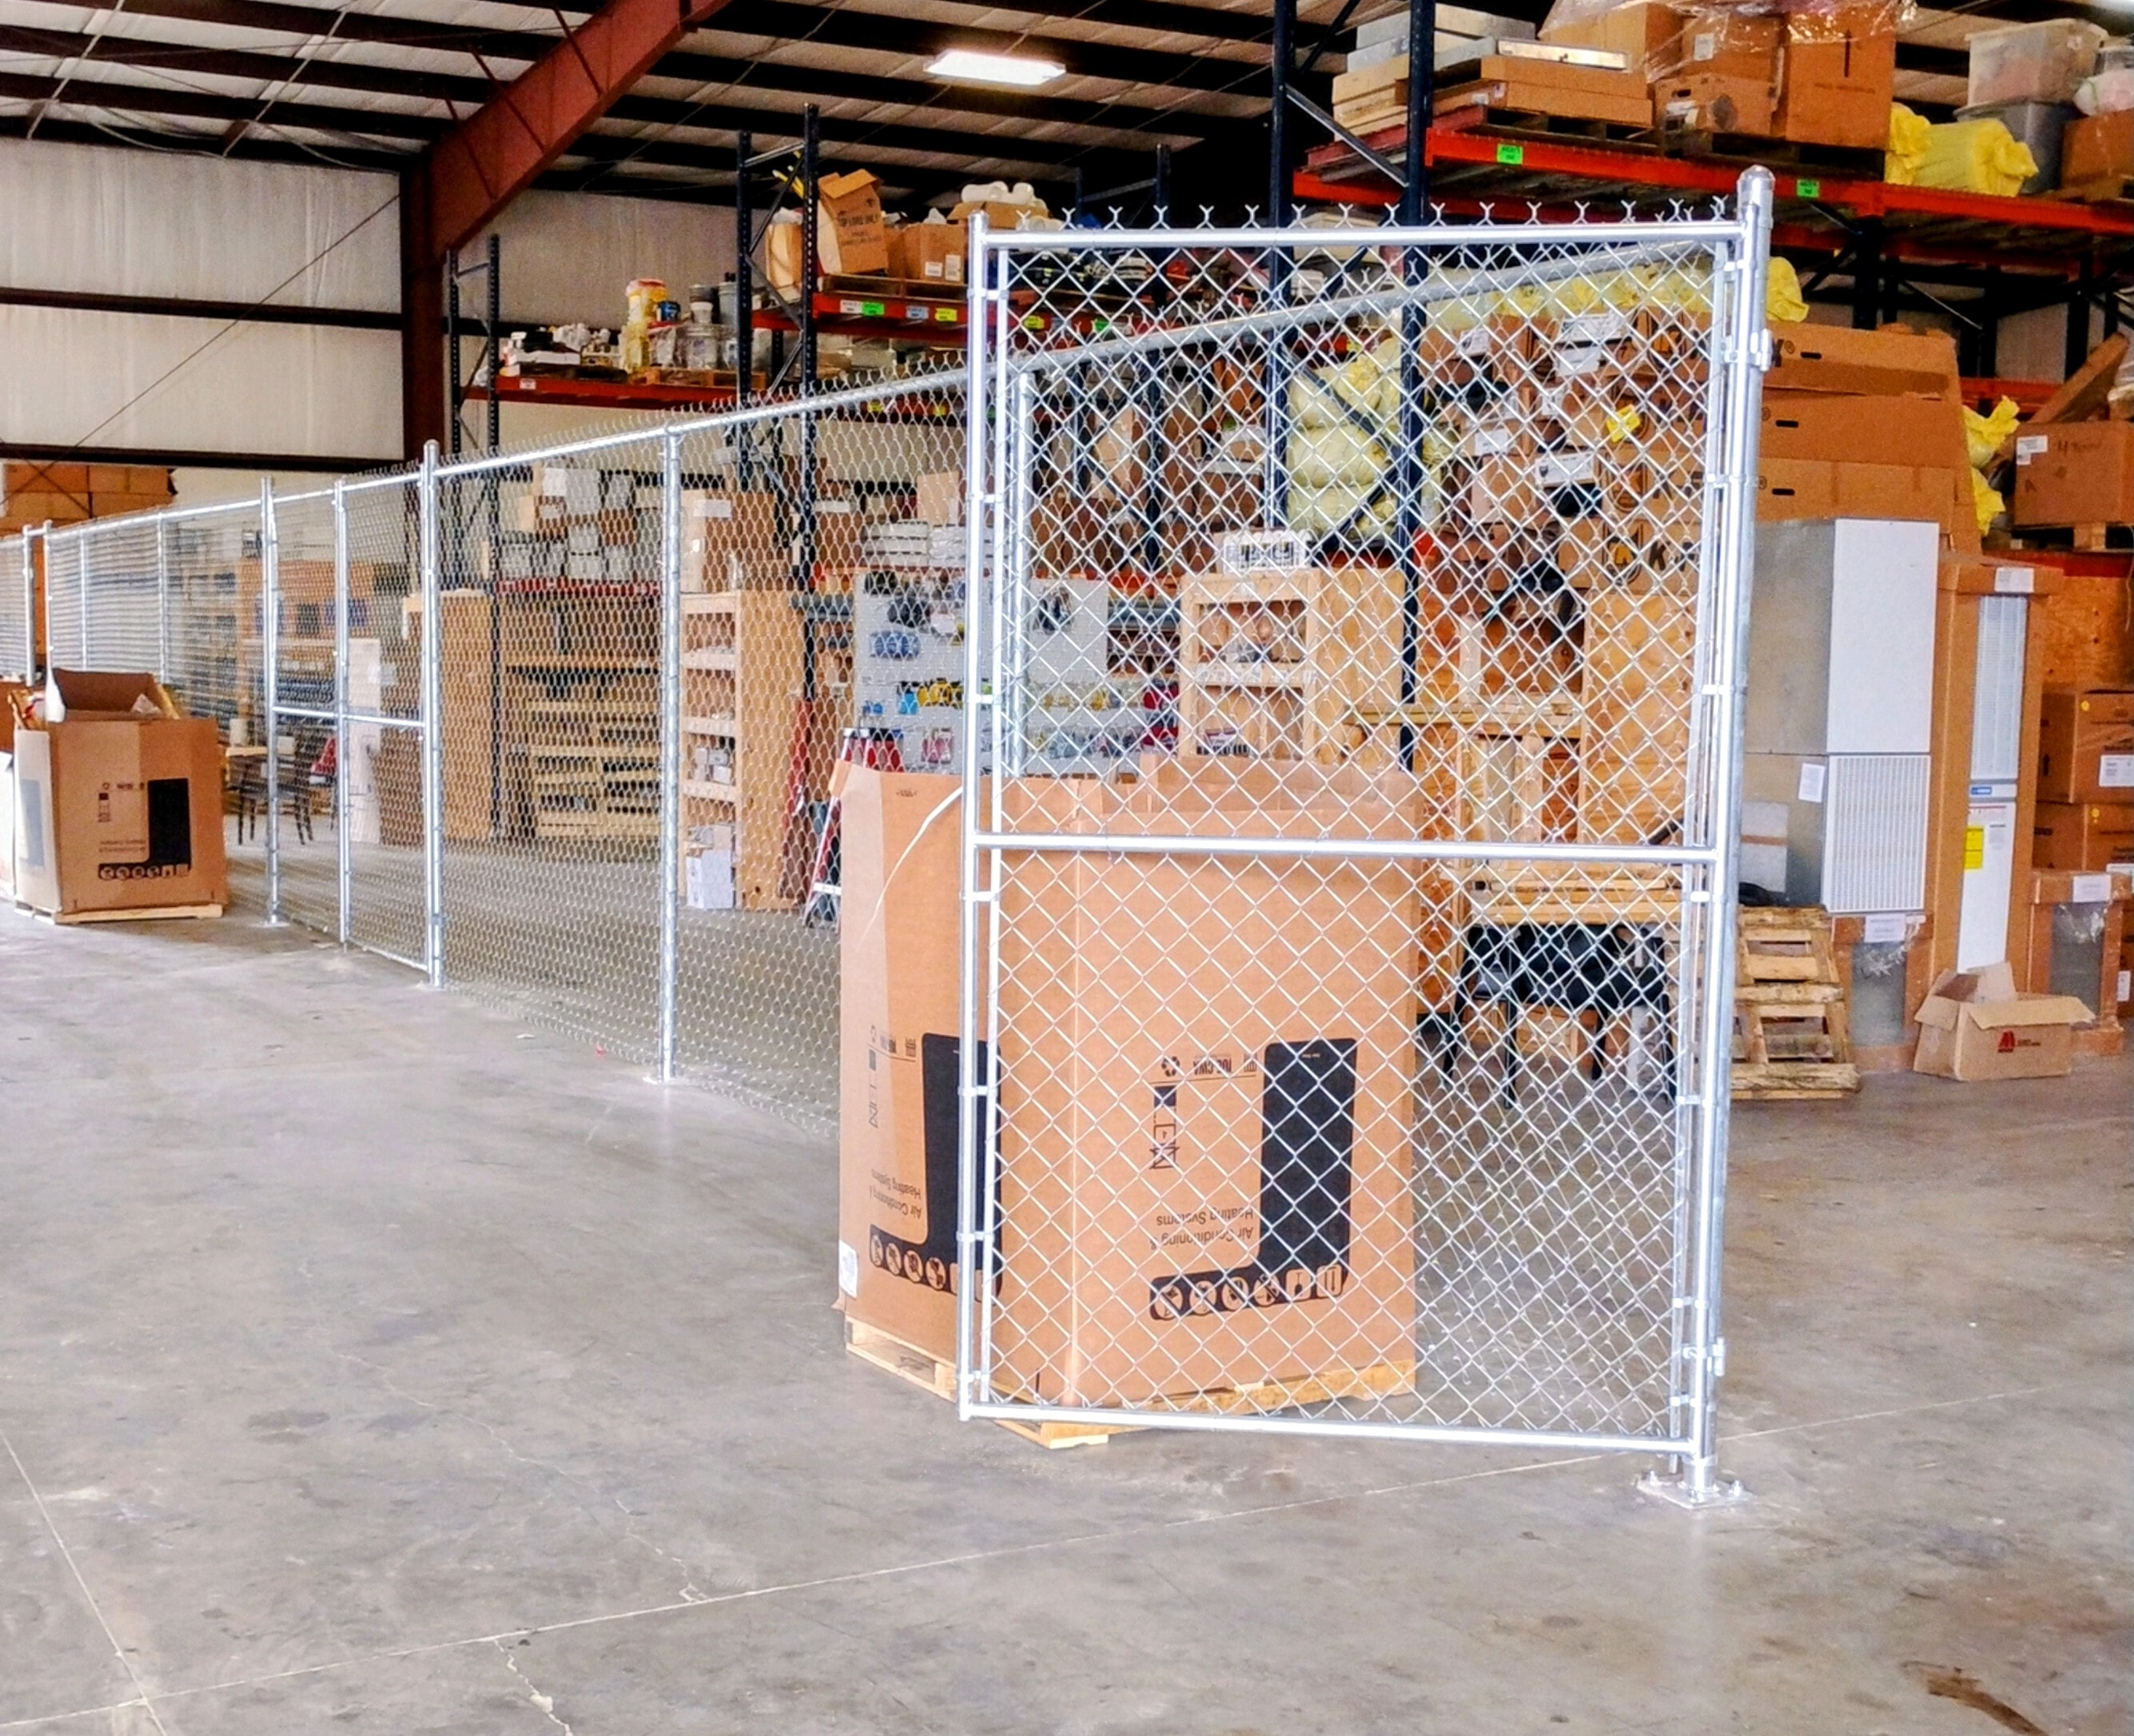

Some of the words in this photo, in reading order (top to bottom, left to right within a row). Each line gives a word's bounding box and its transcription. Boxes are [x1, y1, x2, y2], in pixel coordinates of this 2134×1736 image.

[1157, 1211, 1207, 1225] Systems
[1209, 1207, 1253, 1220] Heating
[1161, 1228, 1233, 1248] Conditioning
[1238, 1227, 1253, 1239] Air
